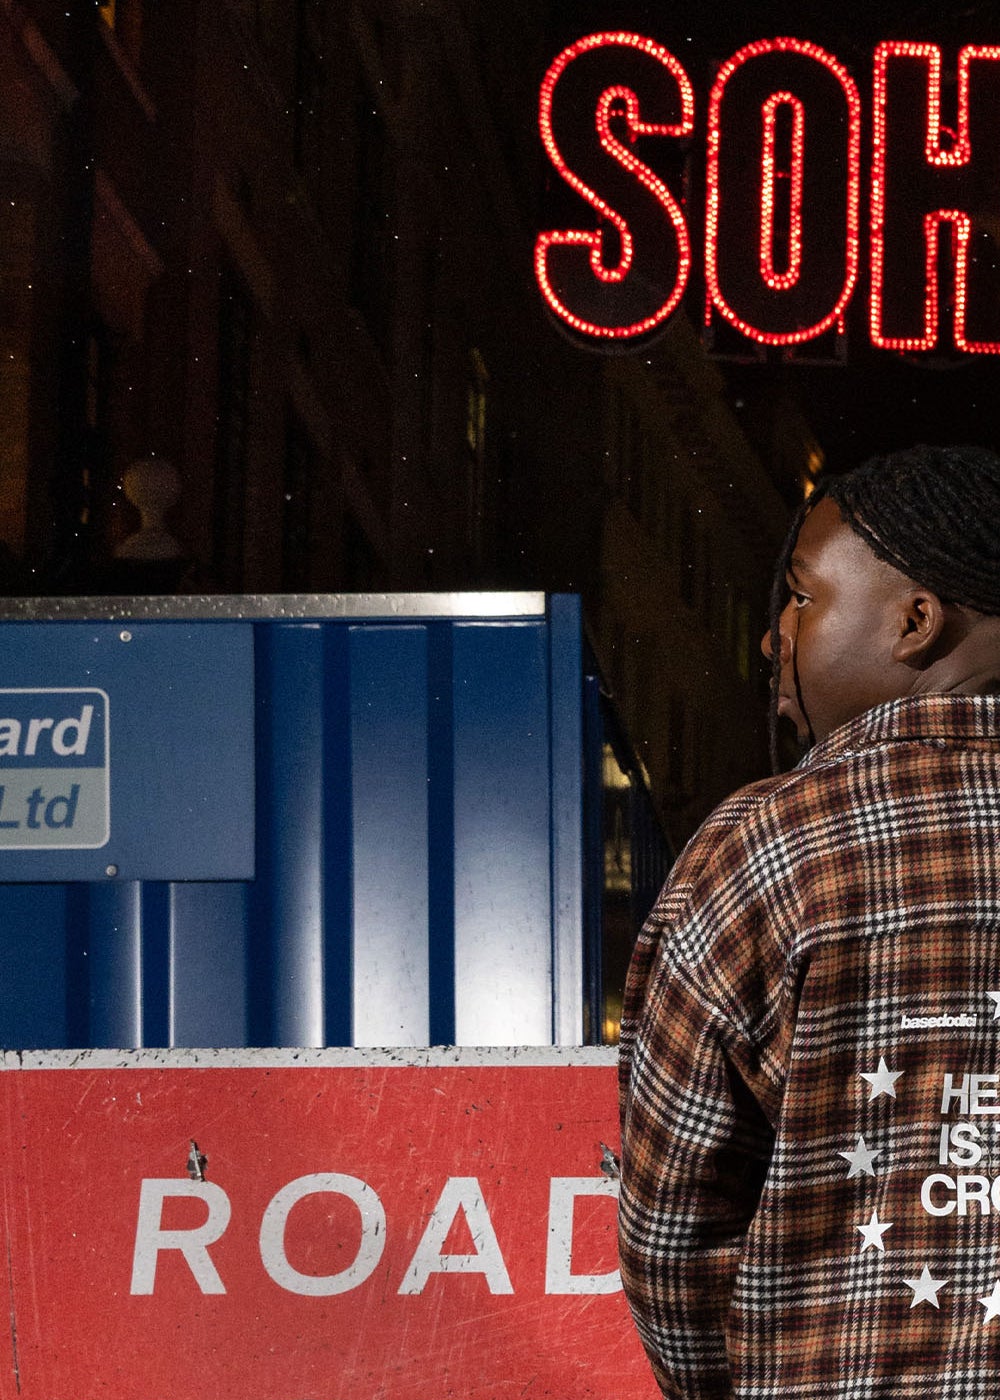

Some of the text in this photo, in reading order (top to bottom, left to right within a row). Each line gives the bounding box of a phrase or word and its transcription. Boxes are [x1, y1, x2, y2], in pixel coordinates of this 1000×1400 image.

[0, 783, 81, 829] Ltd
[939, 1123, 982, 1167] IS
[129, 1172, 626, 1297] ROAD
